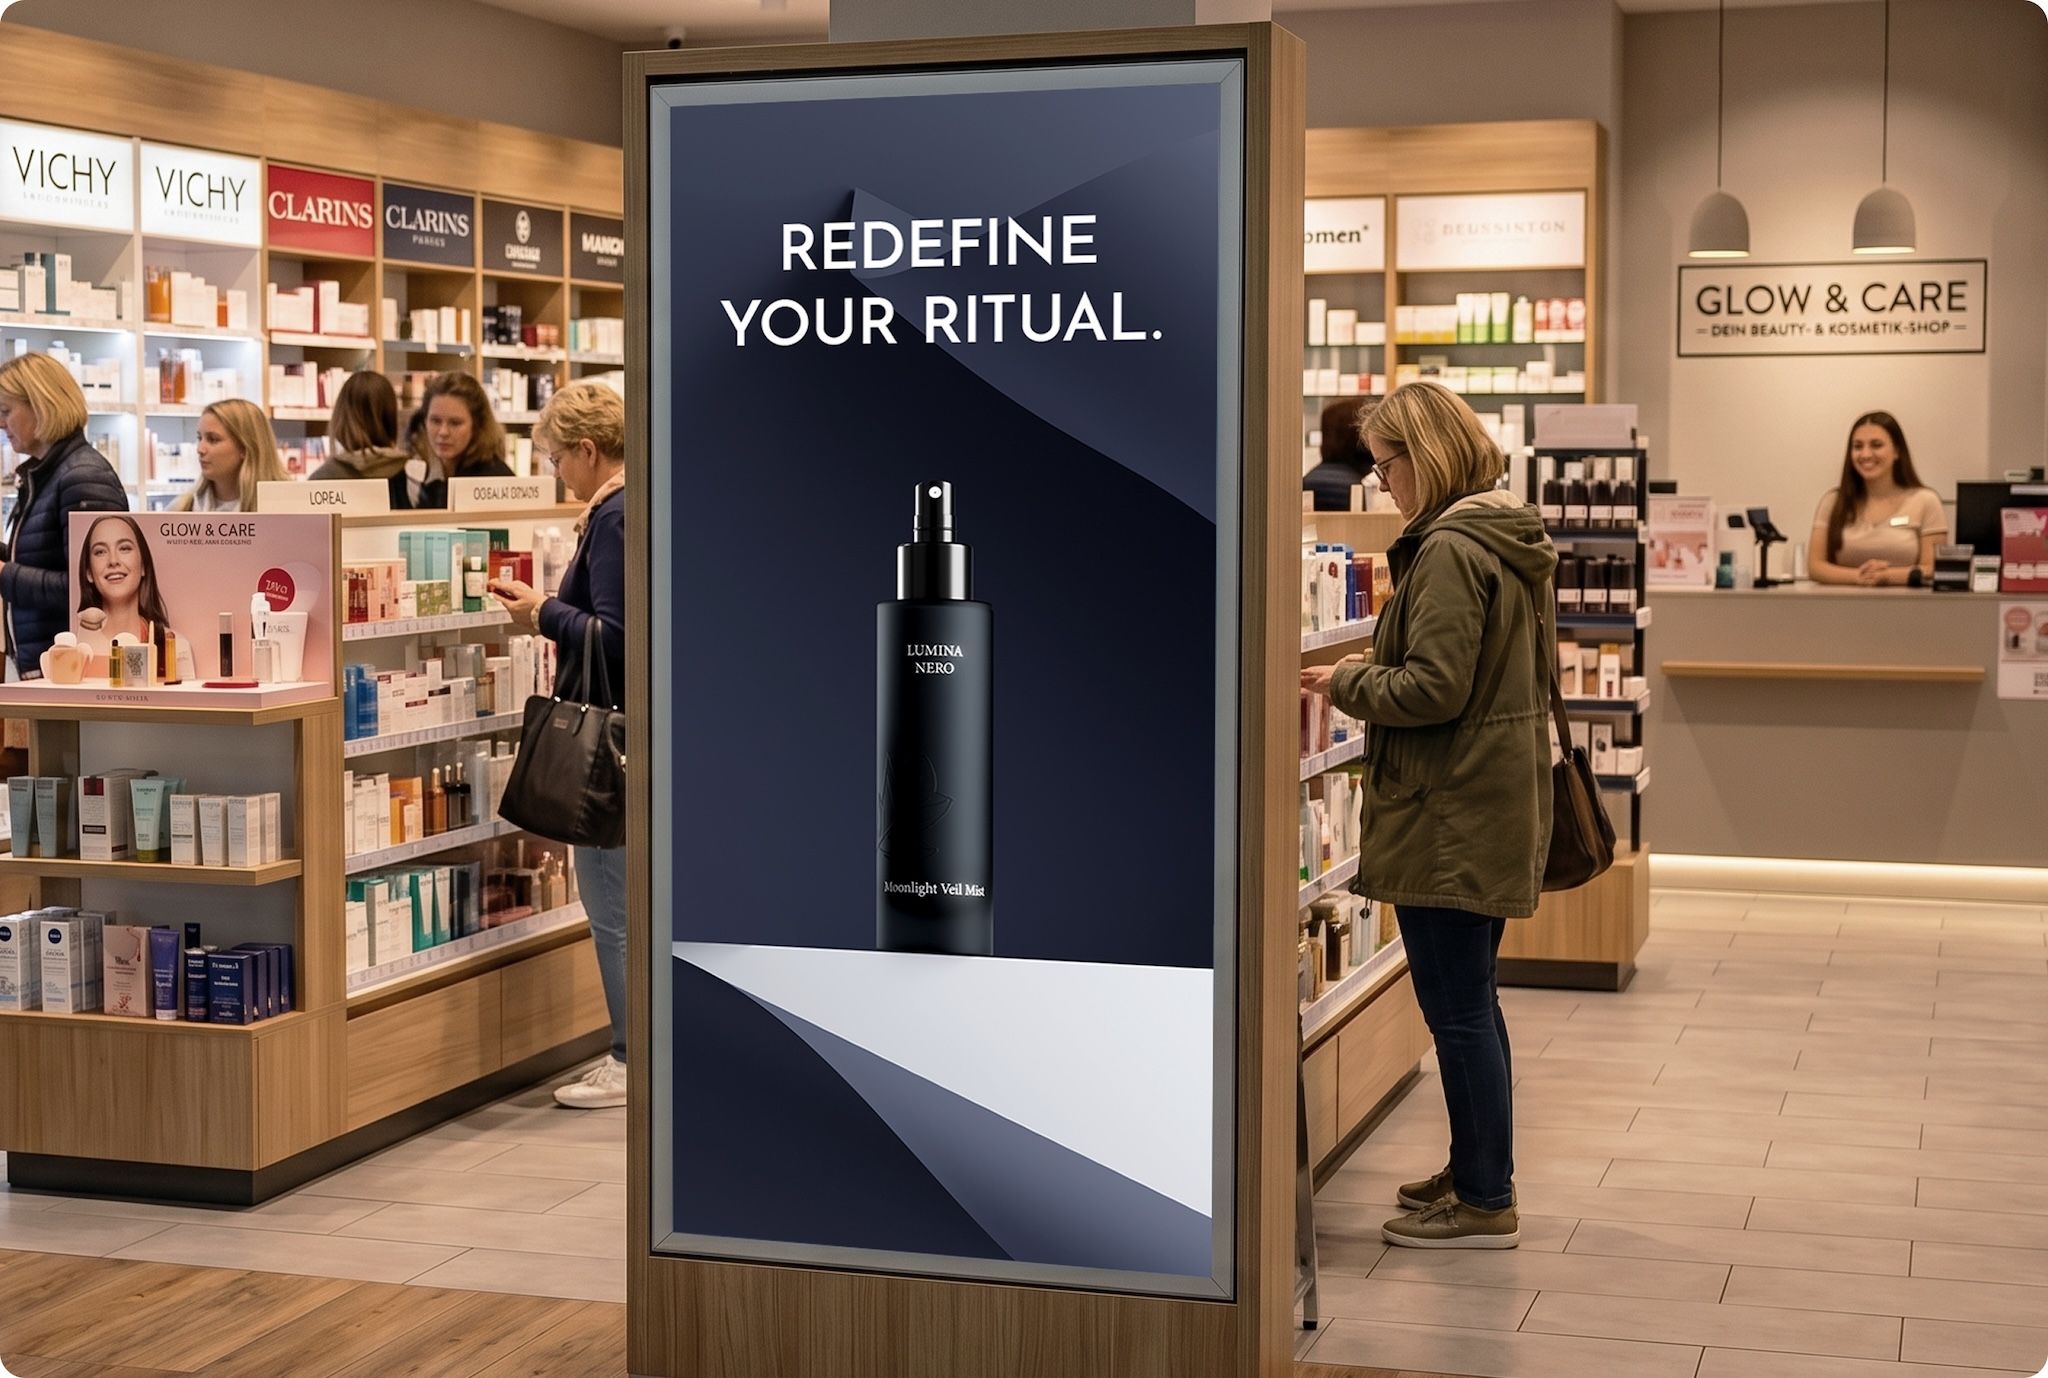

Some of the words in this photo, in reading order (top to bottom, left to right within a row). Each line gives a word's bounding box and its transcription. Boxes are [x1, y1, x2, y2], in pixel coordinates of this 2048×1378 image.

[13, 146, 116, 195] VICHY
[156, 166, 246, 212] VICHY
[268, 190, 374, 230] CLARINS
[386, 204, 470, 237] CLARINS
[782, 214, 1098, 271] REDEFINE
[1696, 284, 1812, 315] GLOW
[1826, 284, 1849, 313] &
[1862, 281, 1968, 313] CARE
[720, 296, 898, 347] YOUR
[925, 290, 1163, 344] RITUAL.
[1712, 324, 1746, 336] DEIN
[1815, 324, 1823, 335] &
[160, 523, 201, 537] GLOW
[205, 523, 215, 537] &
[218, 523, 256, 537] CARE
[907, 644, 963, 657] LUMINA
[915, 662, 955, 674] NERO
[884, 880, 937, 897] Moonlight
[940, 881, 963, 896] Veil
[965, 883, 985, 897] Mist
